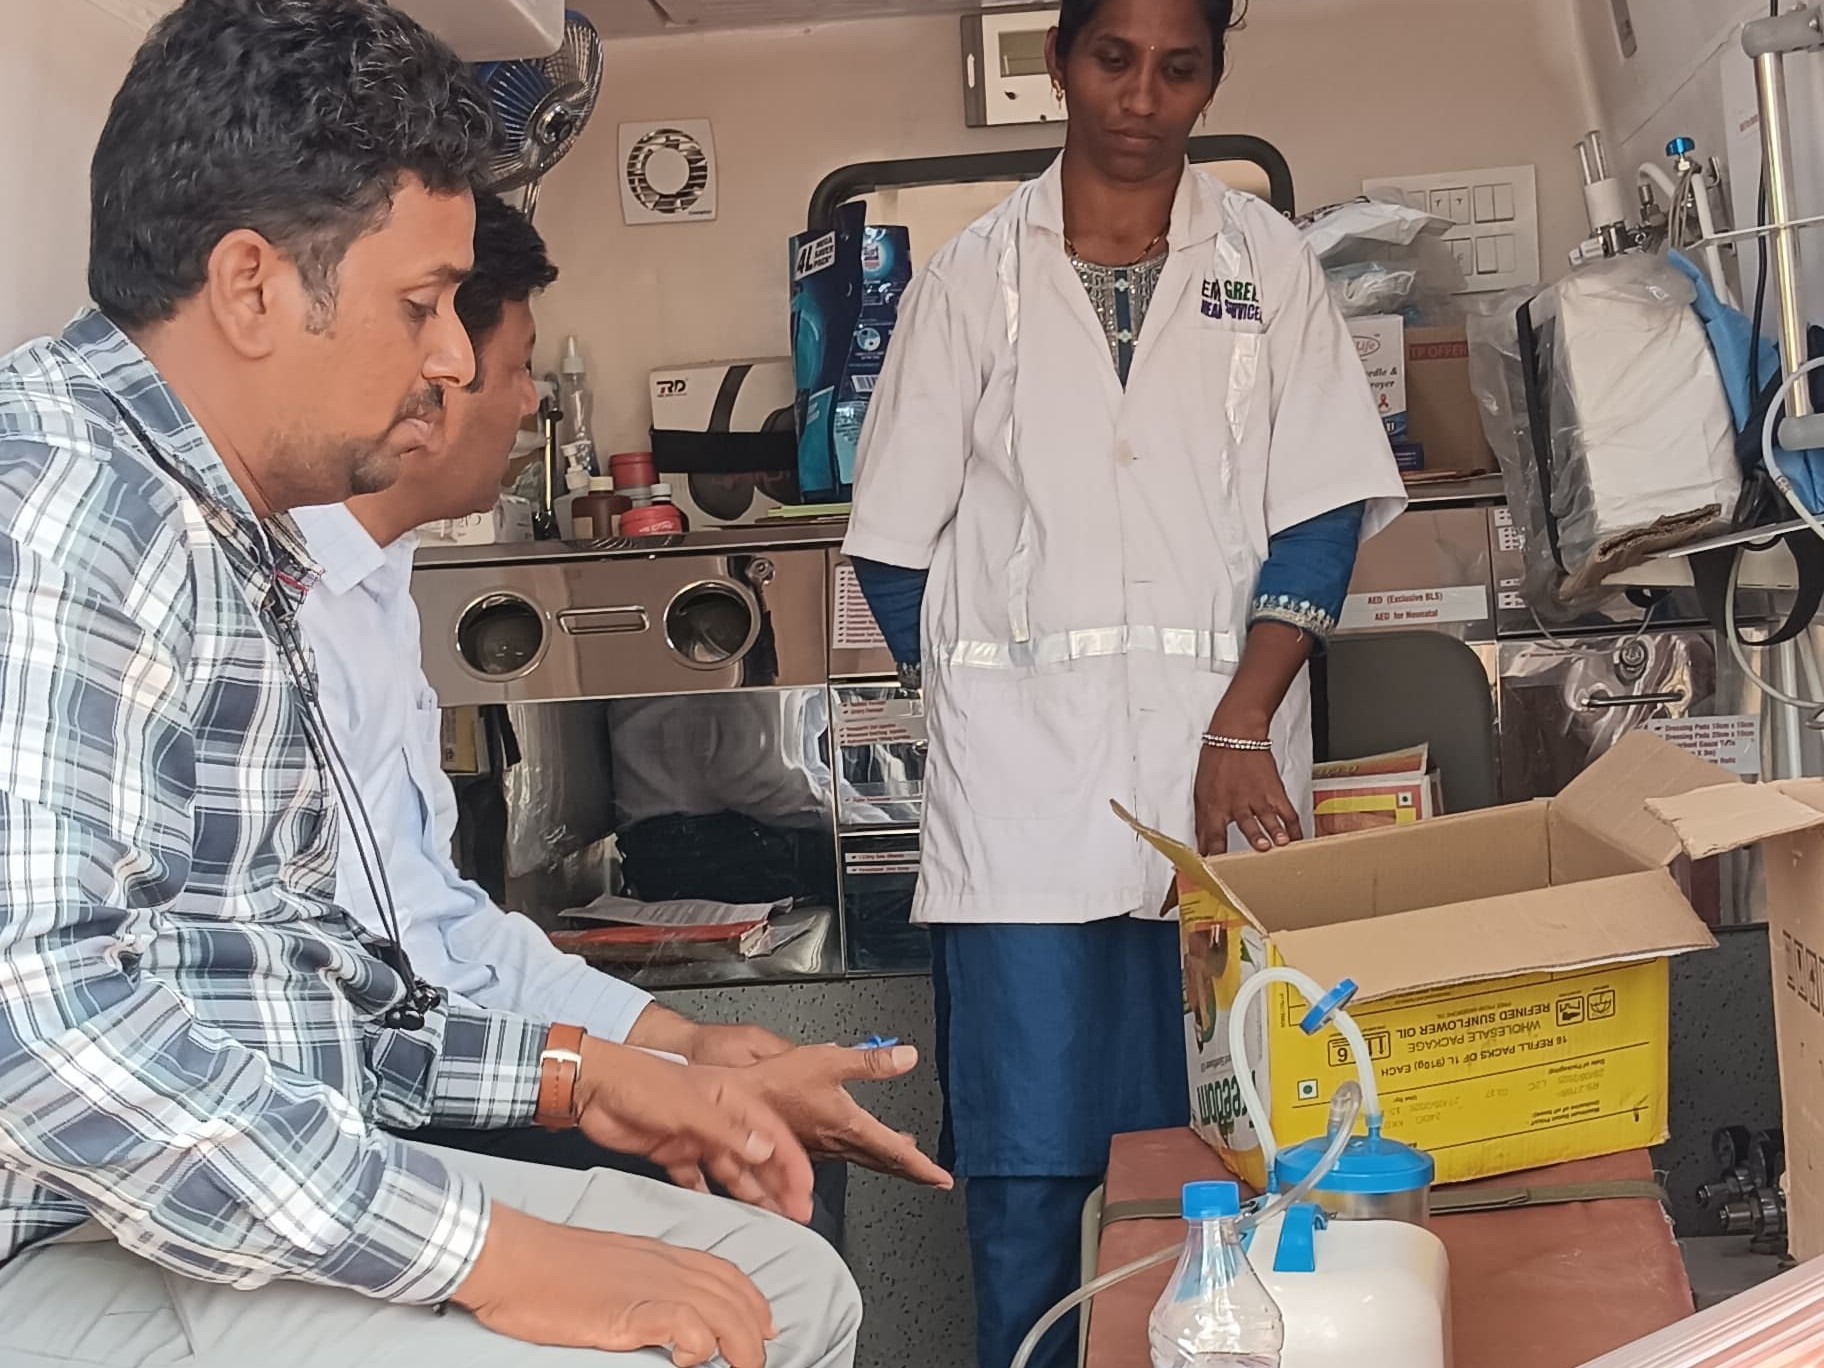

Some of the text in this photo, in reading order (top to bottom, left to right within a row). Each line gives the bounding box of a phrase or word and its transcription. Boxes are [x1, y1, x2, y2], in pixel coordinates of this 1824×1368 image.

[797, 245, 813, 274] 4L
[1367, 596, 1383, 605] AED
[1374, 612, 1390, 621] AED
[1396, 1003, 1550, 1039] REFINED SUNFLOWER OIL
[1407, 1020, 1540, 1053] WHOLESALE PACKAGE
[1519, 1038, 1554, 1052] REFILL
[1337, 1048, 1347, 1062] 6
[1463, 1052, 1478, 1063] OF
[1480, 1045, 1516, 1060] PACKS
[1381, 1064, 1411, 1077] EACH
